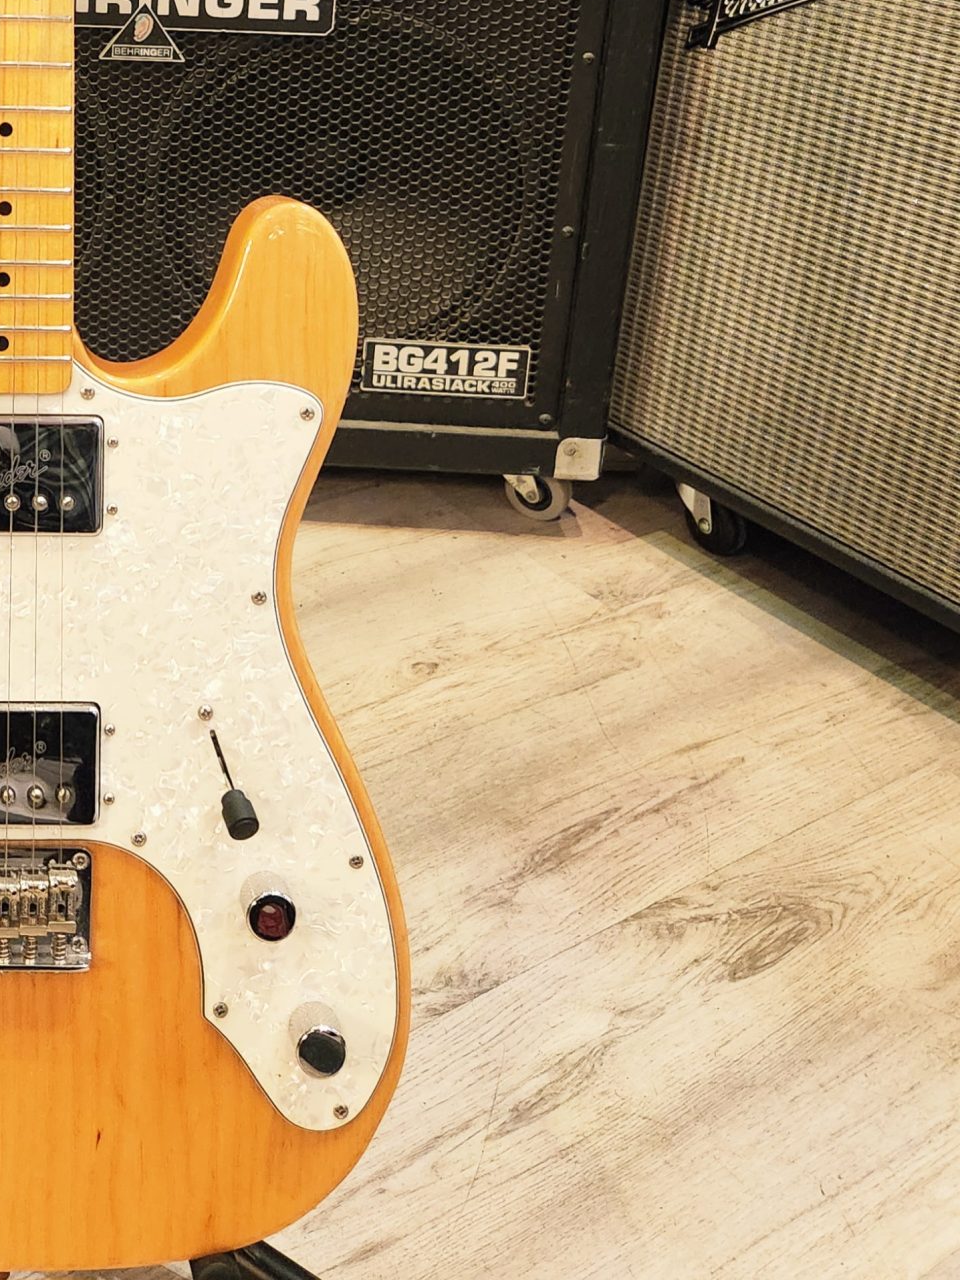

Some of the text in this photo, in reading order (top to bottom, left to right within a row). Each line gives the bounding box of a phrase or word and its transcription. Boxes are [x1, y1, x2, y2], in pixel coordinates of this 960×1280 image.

[114, 47, 170, 57] BEHRINGER
[372, 344, 520, 378] BG412F
[372, 373, 490, 393] ULTRASTACK
